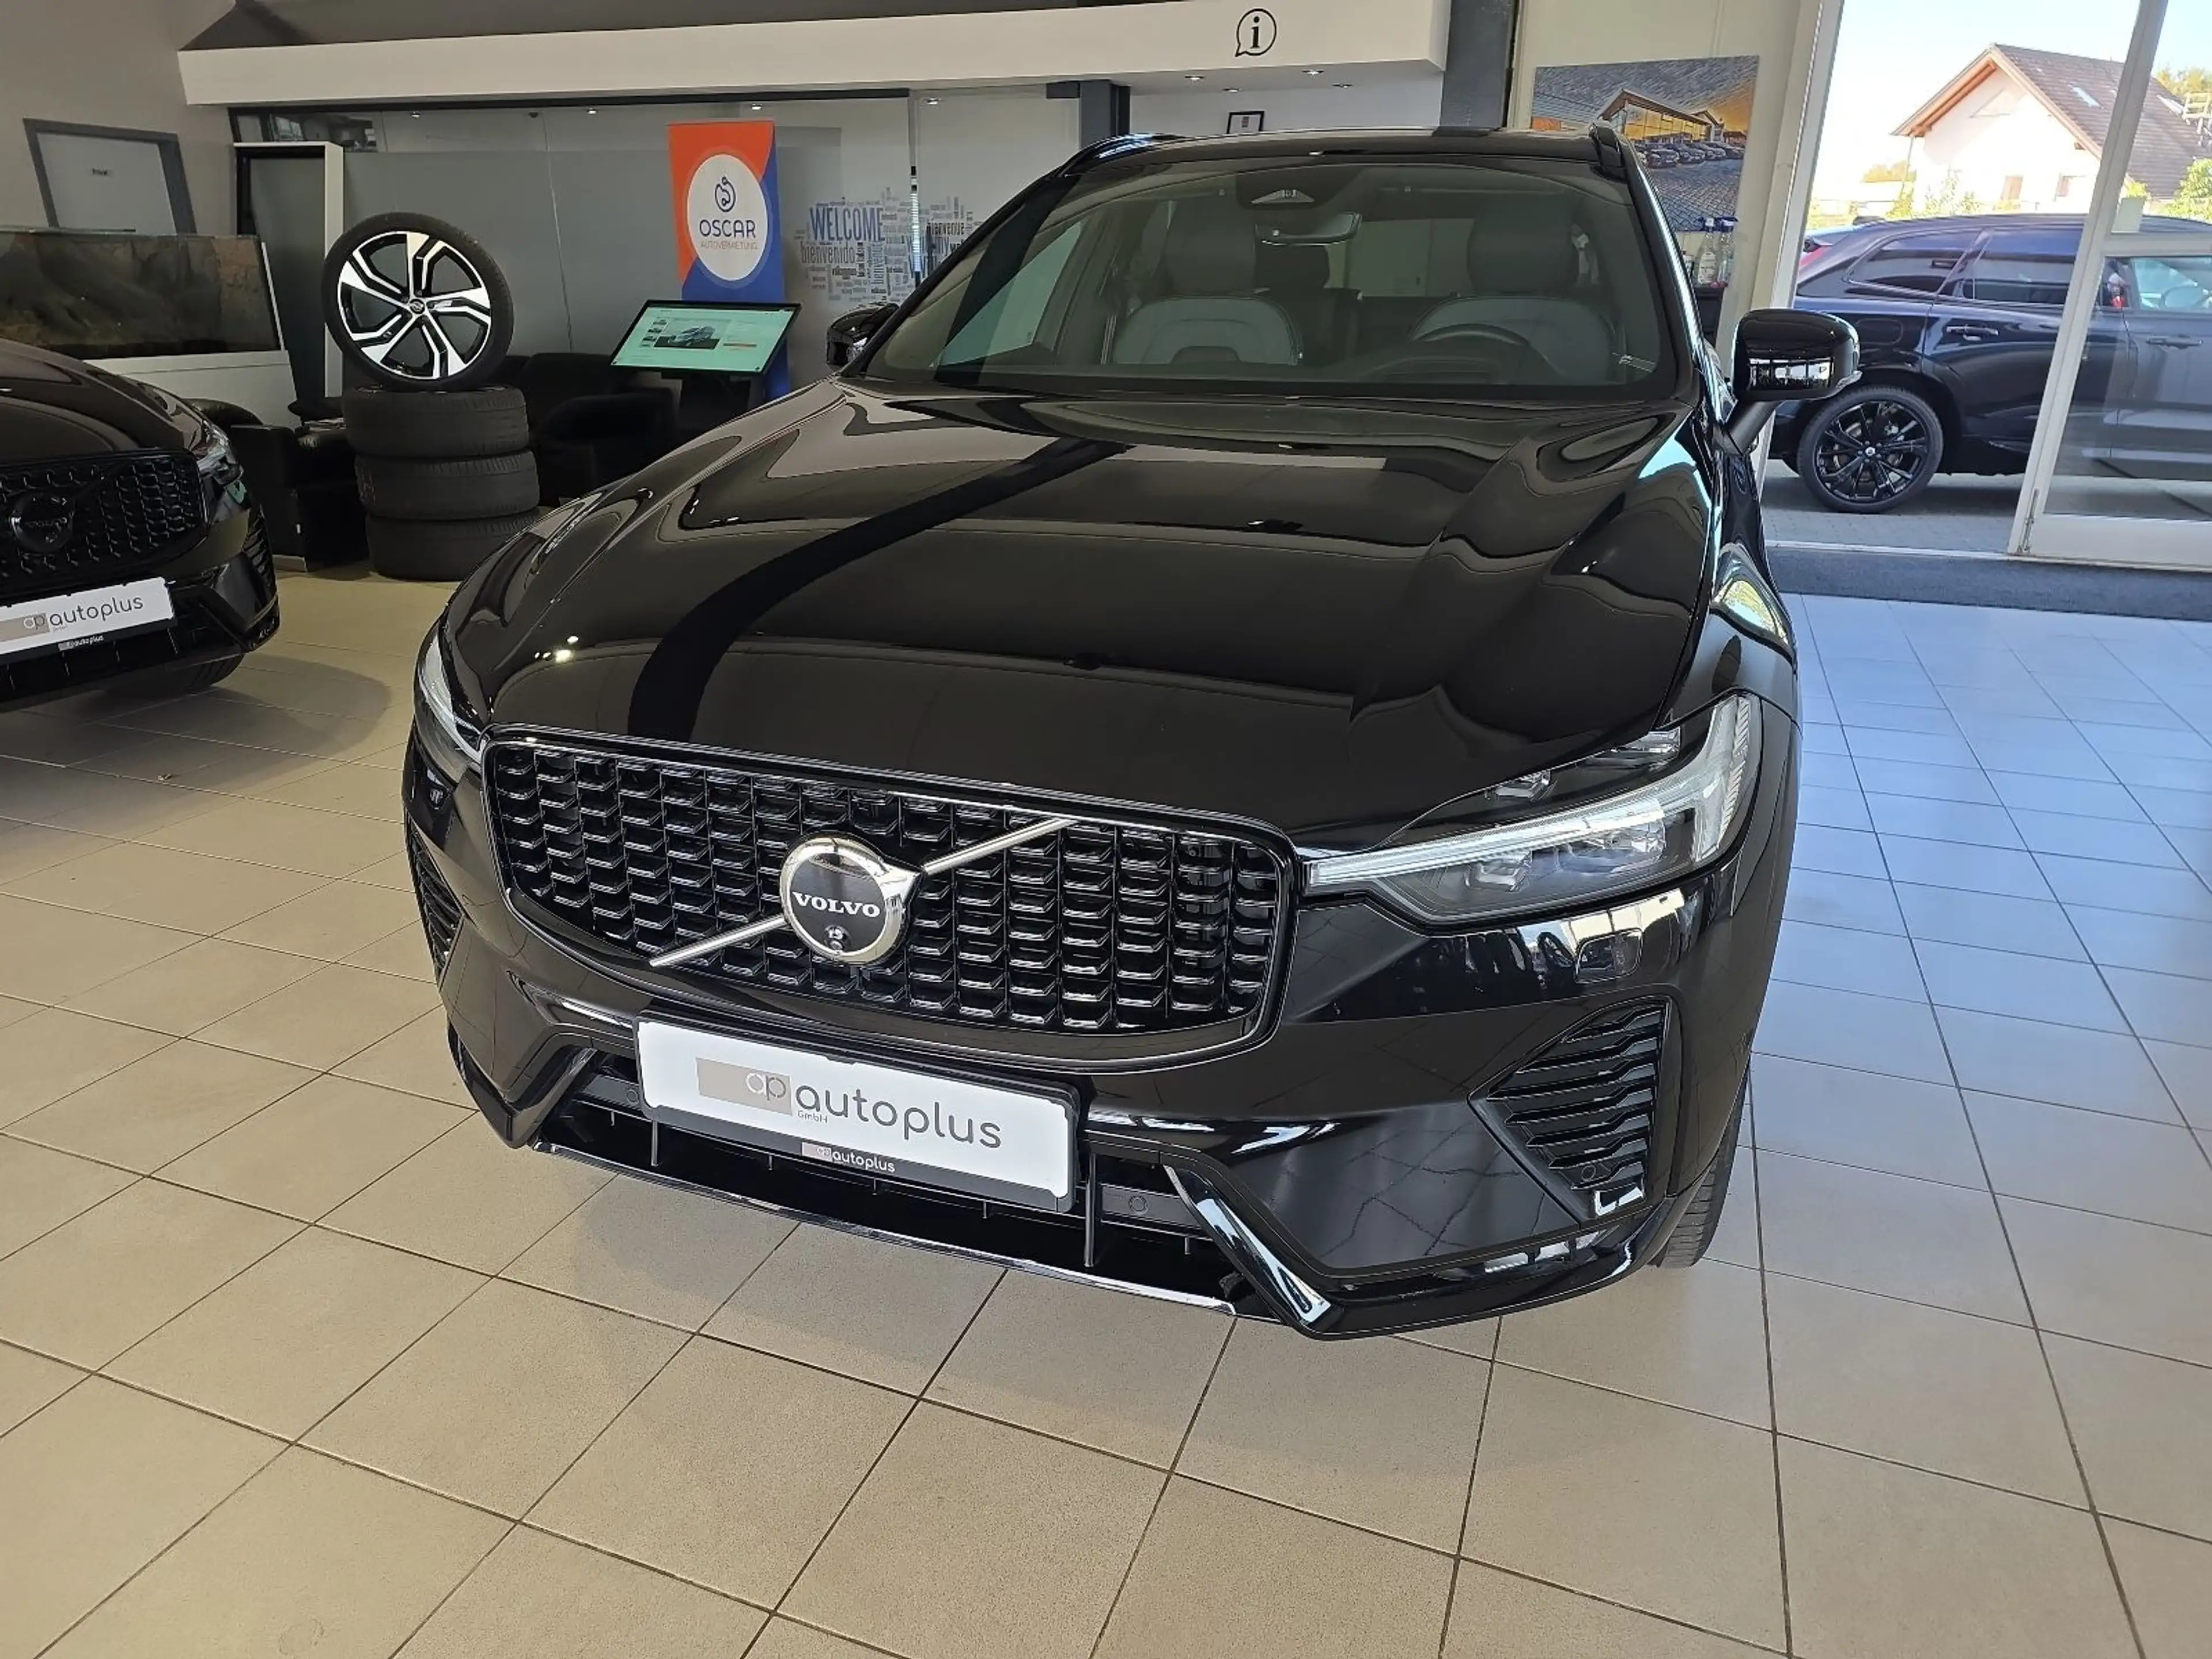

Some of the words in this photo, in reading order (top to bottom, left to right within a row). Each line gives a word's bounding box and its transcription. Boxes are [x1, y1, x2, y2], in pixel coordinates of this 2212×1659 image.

[699, 219, 756, 238] OSCAR
[809, 207, 885, 241] WELCOME
[800, 241, 855, 264] bienvenido
[49, 597, 144, 626] autoplus
[792, 891, 880, 918] VOLVO
[795, 1085, 1002, 1149] autoplus
[797, 1109, 828, 1124] GmbH
[832, 1151, 896, 1173] autoplus
